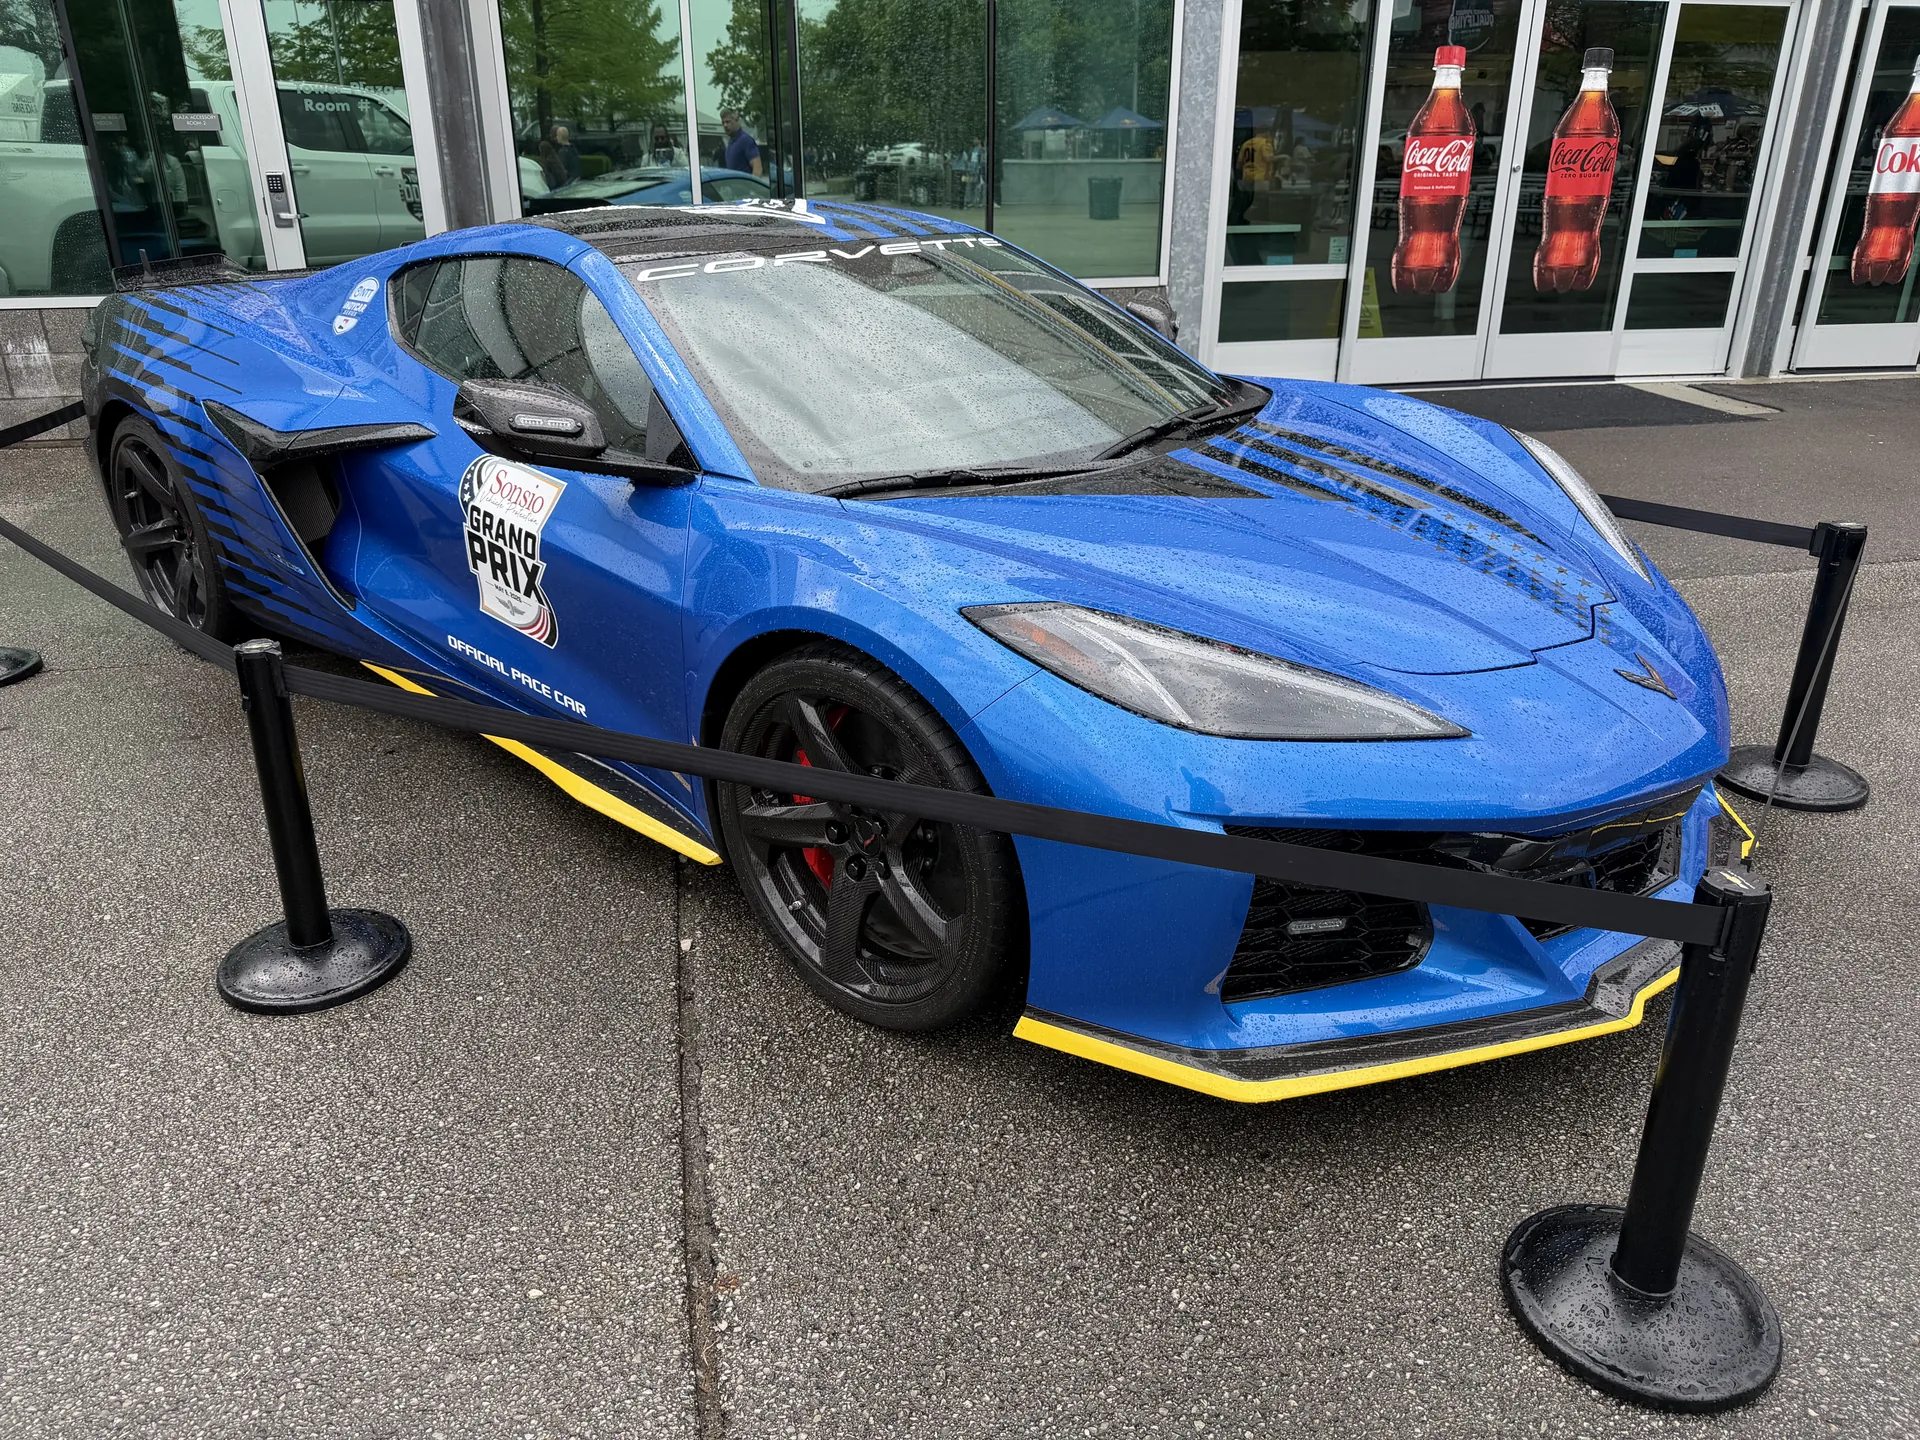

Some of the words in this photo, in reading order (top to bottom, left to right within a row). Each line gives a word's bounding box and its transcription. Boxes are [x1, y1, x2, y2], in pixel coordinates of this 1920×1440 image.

[296, 82, 341, 94] Tower
[350, 82, 395, 95] Plaza
[304, 98, 350, 112] Room
[358, 99, 371, 112] #
[378, 100, 389, 112] 2
[1404, 140, 1473, 172] Coca-Cola
[1550, 142, 1617, 173] Coca-Cola
[637, 237, 1003, 282] CORVETTE
[490, 469, 545, 514] Sonsio
[470, 505, 536, 560] GRAND
[467, 530, 544, 604] PRIX
[447, 635, 510, 677] OFFICIAL
[510, 667, 553, 700] PACE
[553, 690, 588, 719] CAR
